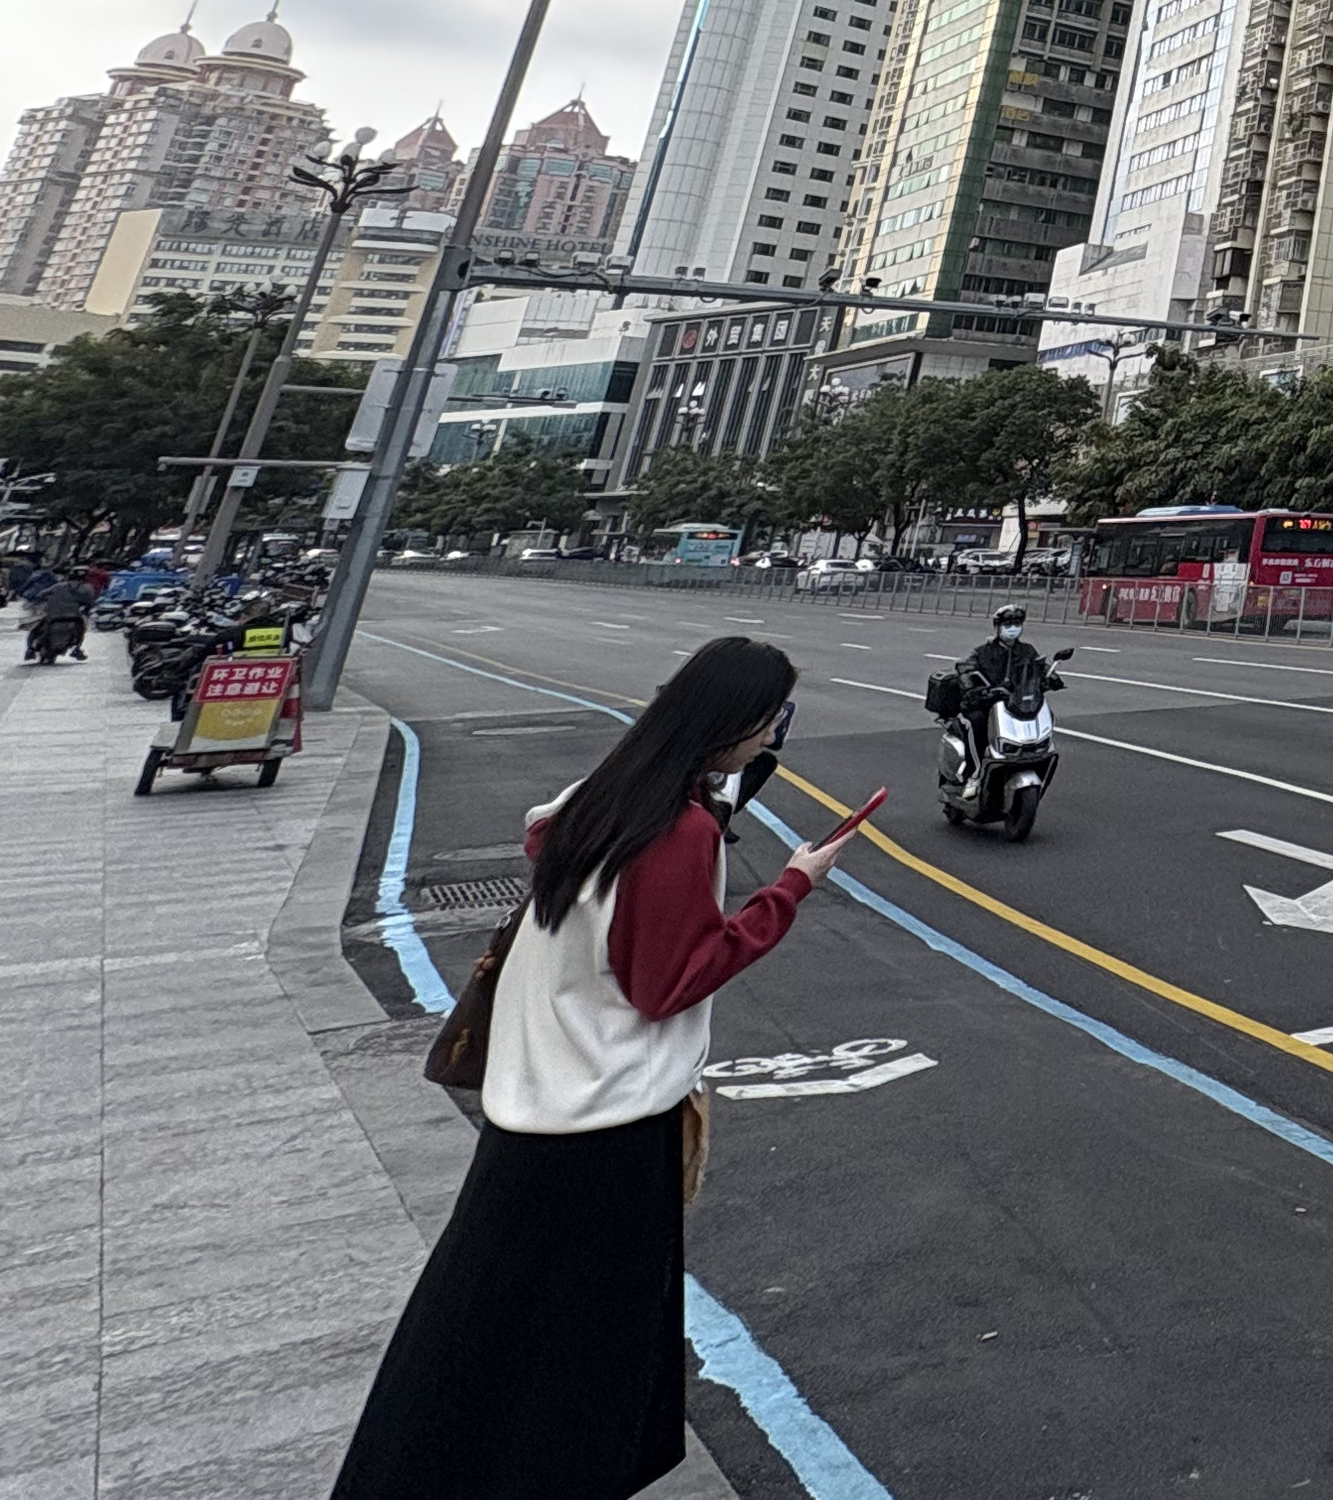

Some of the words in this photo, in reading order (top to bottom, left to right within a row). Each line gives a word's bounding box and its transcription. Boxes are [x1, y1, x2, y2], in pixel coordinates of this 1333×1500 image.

[545, 239, 608, 253] HOTEL
[210, 666, 284, 681] 环卫作业
